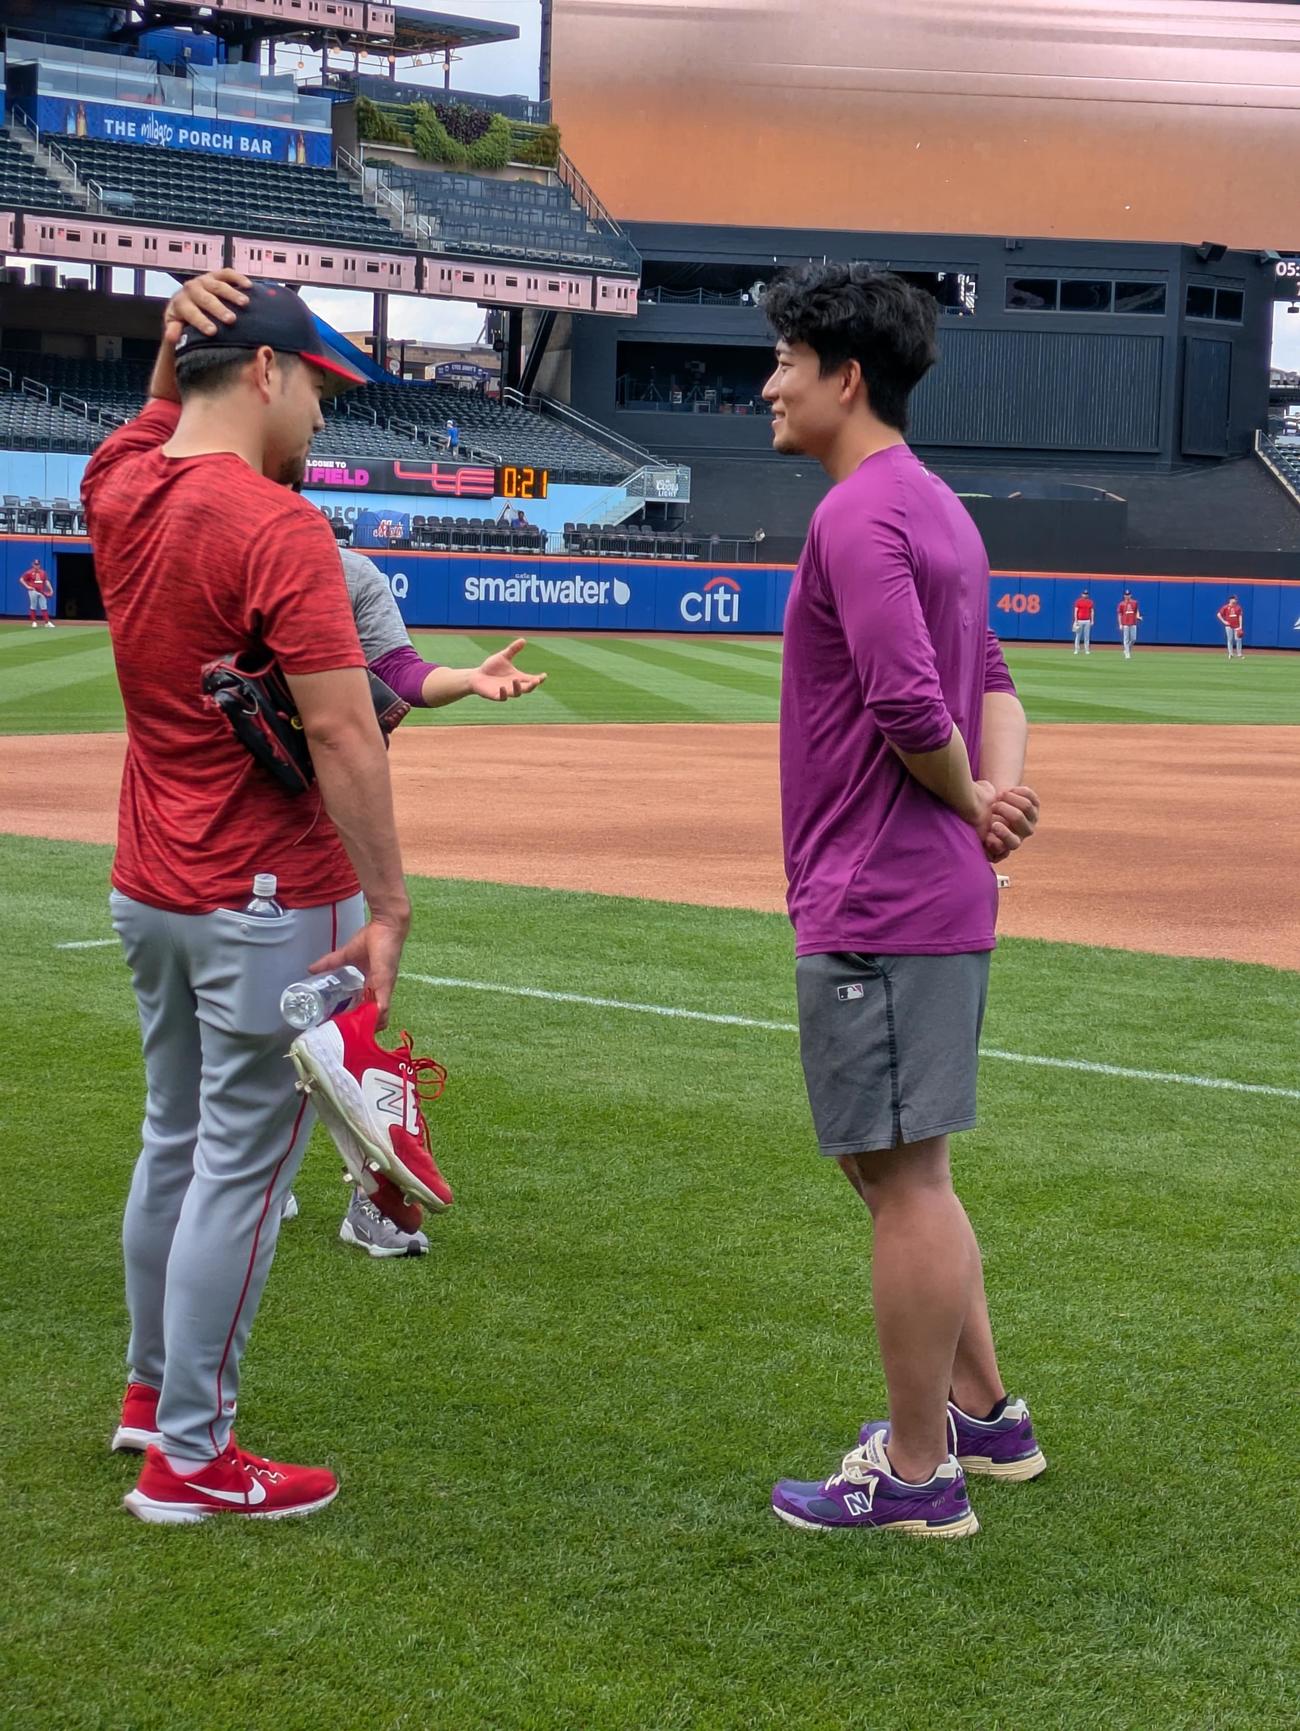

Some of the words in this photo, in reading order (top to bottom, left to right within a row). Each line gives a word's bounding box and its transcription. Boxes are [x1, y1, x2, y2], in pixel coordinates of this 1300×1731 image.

[104, 119, 136, 137] THE
[179, 128, 233, 150] PORCH
[240, 136, 272, 155] BAR
[311, 467, 370, 487] FIELD
[335, 461, 347, 469] TO
[503, 467, 548, 499] 0:21
[464, 574, 610, 605] smartwater
[680, 585, 739, 622] citi
[997, 593, 1041, 614] 408
